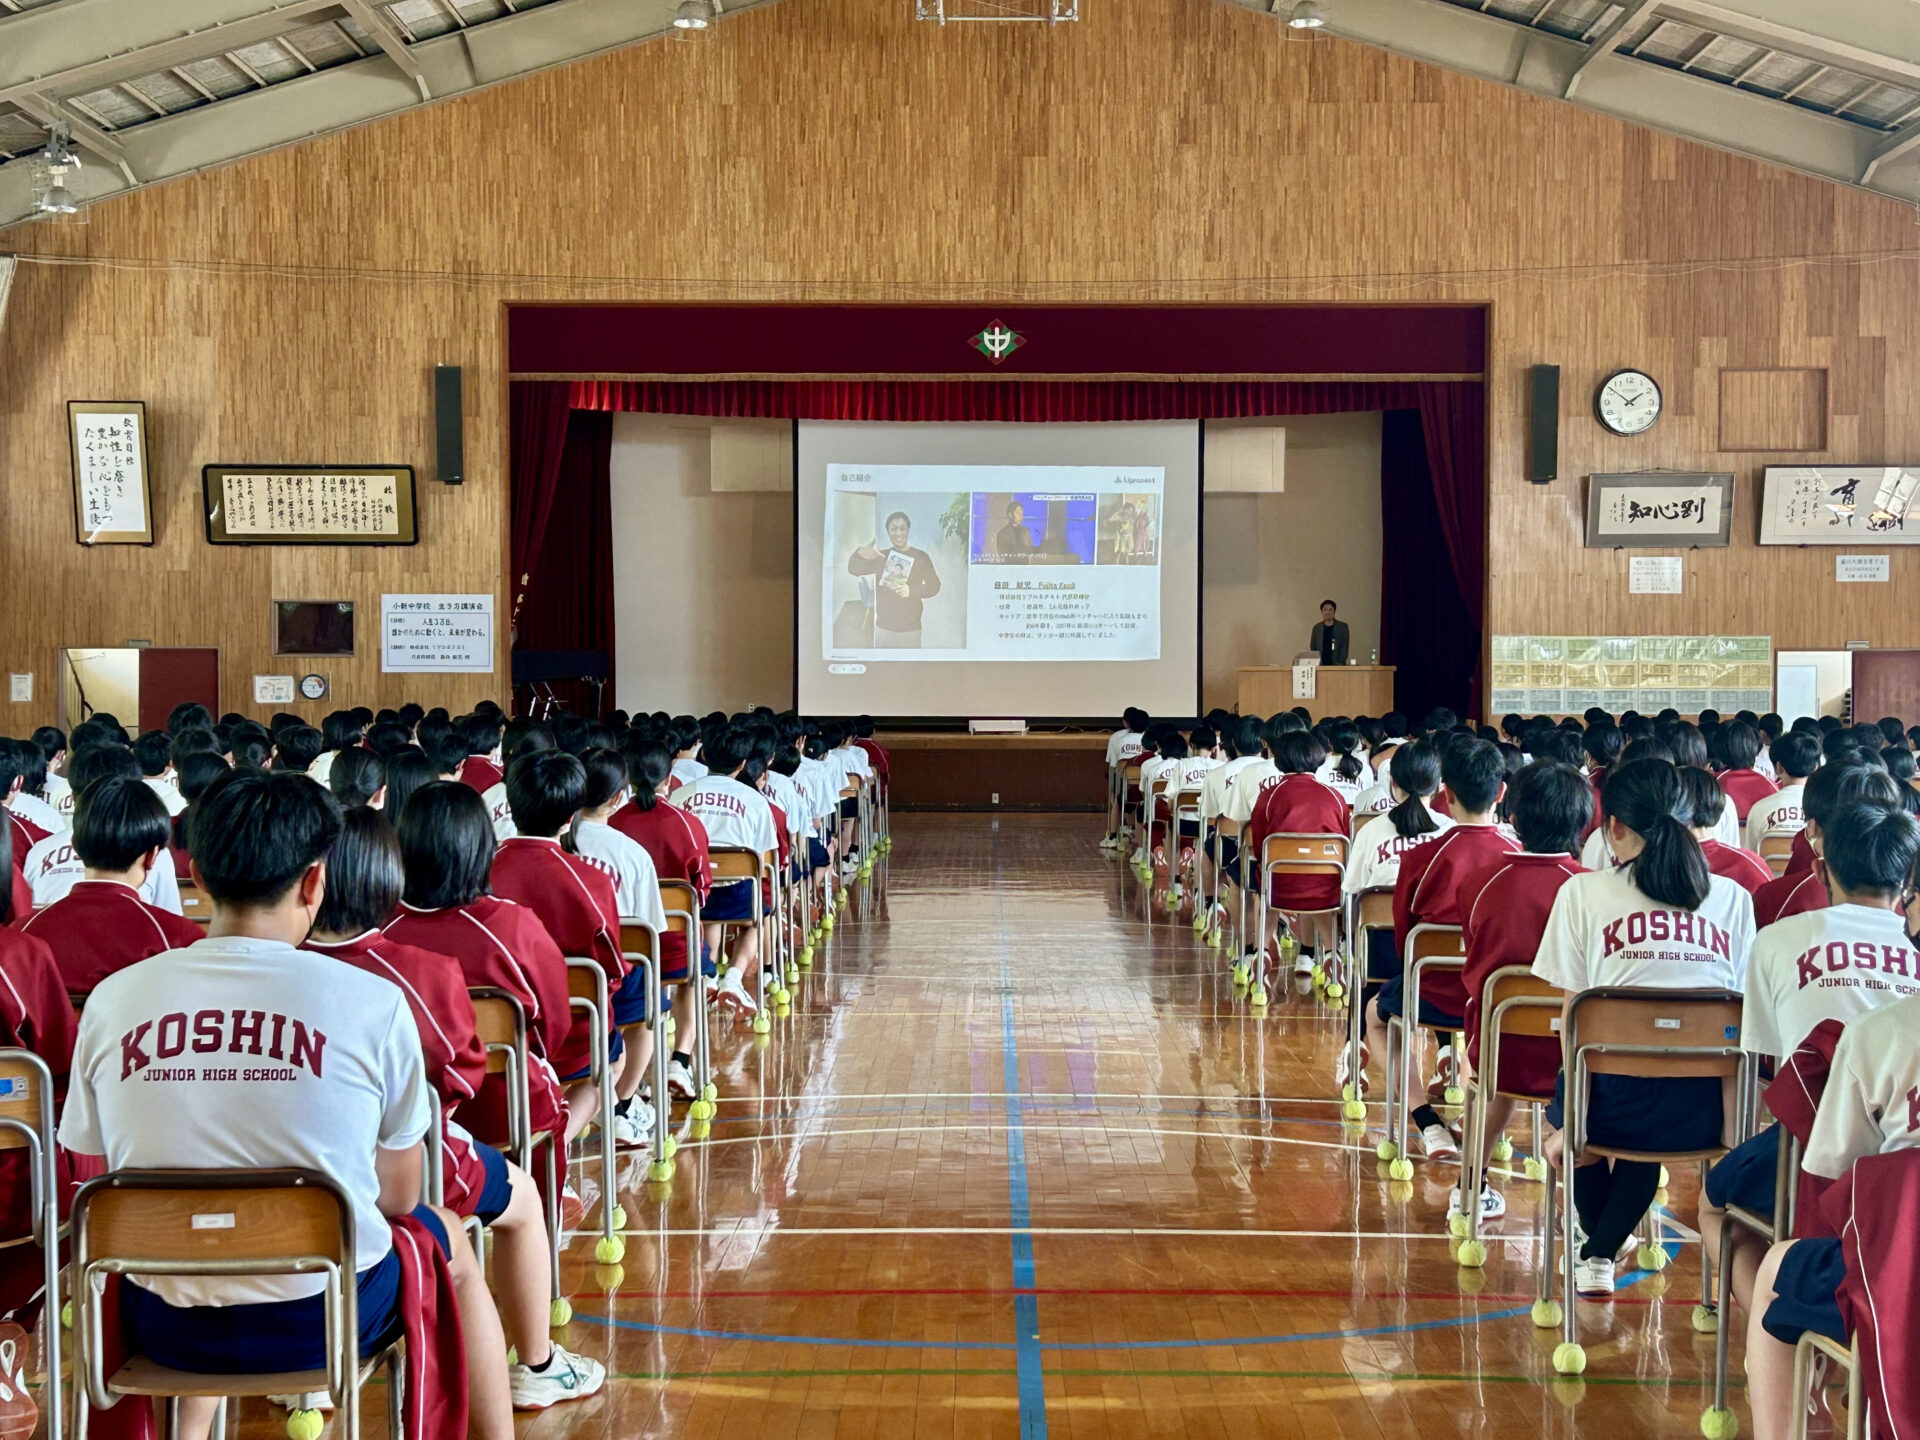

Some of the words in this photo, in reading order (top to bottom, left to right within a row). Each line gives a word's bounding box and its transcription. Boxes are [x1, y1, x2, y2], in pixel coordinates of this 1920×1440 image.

[683, 792, 746, 818] KOSHIN
[1603, 910, 1730, 962] KOSHIN
[1620, 950, 1655, 960] JUNIOR
[1658, 951, 1680, 961] HIGH
[1684, 952, 1716, 962] SCHOOL
[1818, 977, 1860, 988] JUNIOR
[121, 1009, 327, 1082] KOSHIN
[143, 1068, 196, 1081] JUNIOR
[202, 1068, 238, 1081] HIGH
[243, 1068, 297, 1081] SCHOOL
